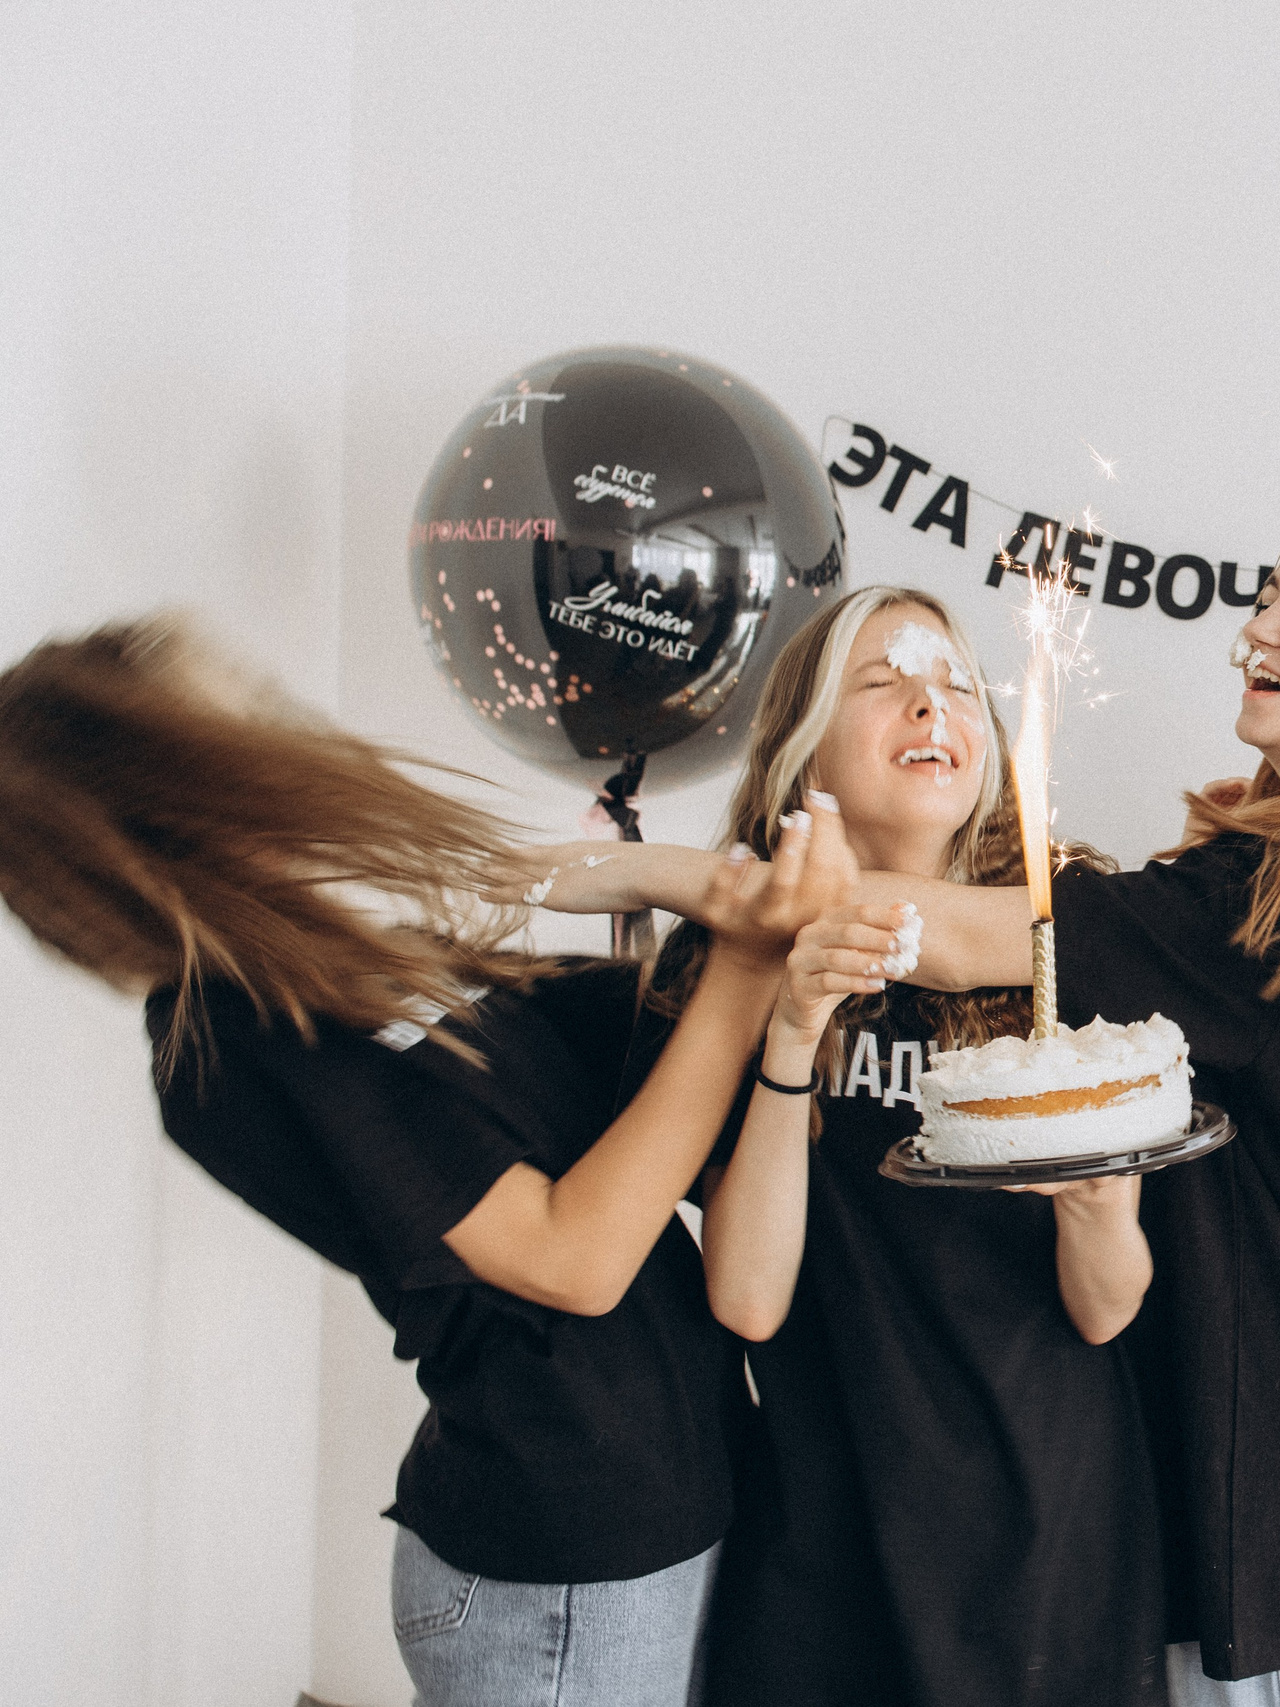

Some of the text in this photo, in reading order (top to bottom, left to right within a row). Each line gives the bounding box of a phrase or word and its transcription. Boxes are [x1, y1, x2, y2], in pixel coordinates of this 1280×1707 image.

[611, 464, 657, 494] ВСЁ
[828, 424, 969, 548] ЭТА
[985, 511, 1275, 620] ДЕВОЧ
[549, 601, 700, 662] ТЕБЕ ЭТО ИДЁТ
